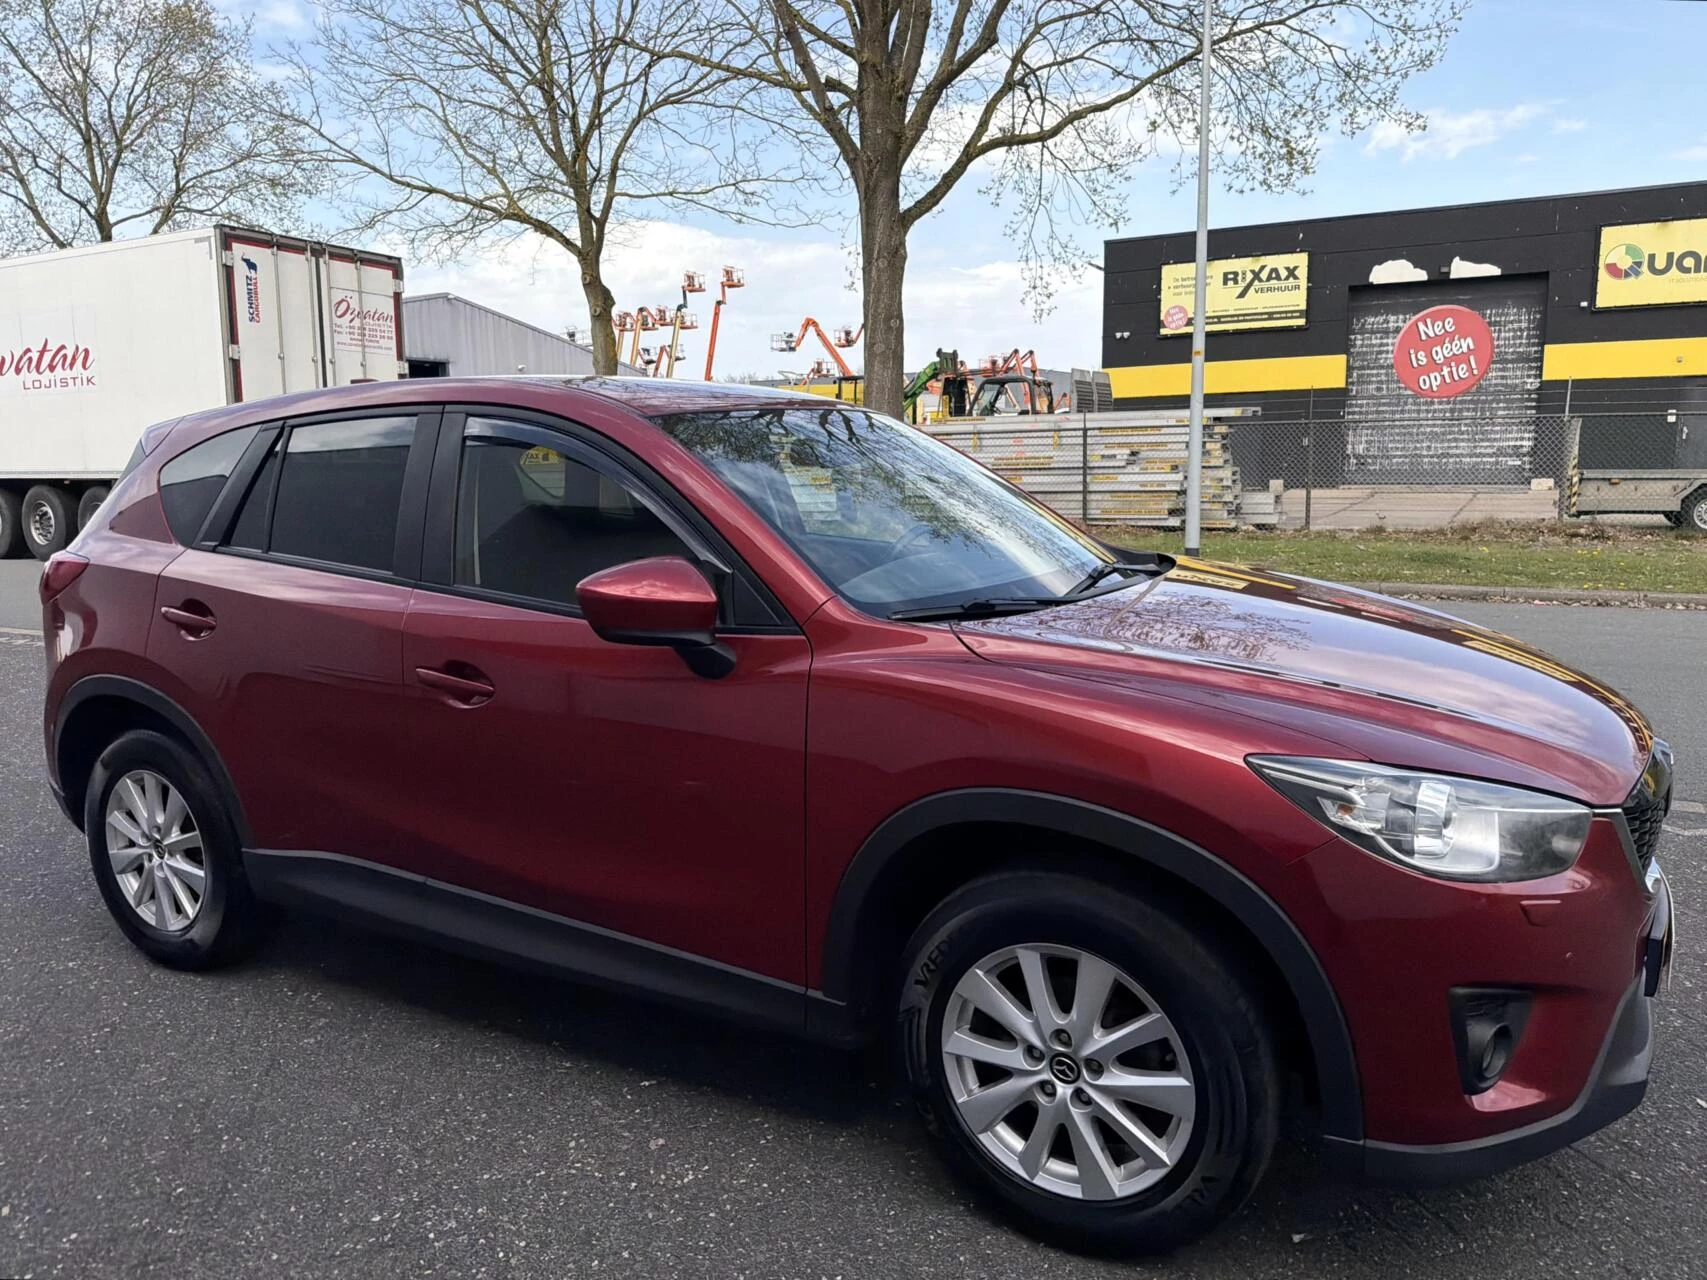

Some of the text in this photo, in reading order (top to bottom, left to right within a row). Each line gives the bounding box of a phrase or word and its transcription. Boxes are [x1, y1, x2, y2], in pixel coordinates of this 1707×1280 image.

[246, 275, 255, 322] SCHMITZ
[1254, 284, 1300, 294] VERHUUR
[1417, 317, 1455, 340] Nee
[1409, 335, 1474, 368] is géén
[1419, 355, 1478, 391] optie!
